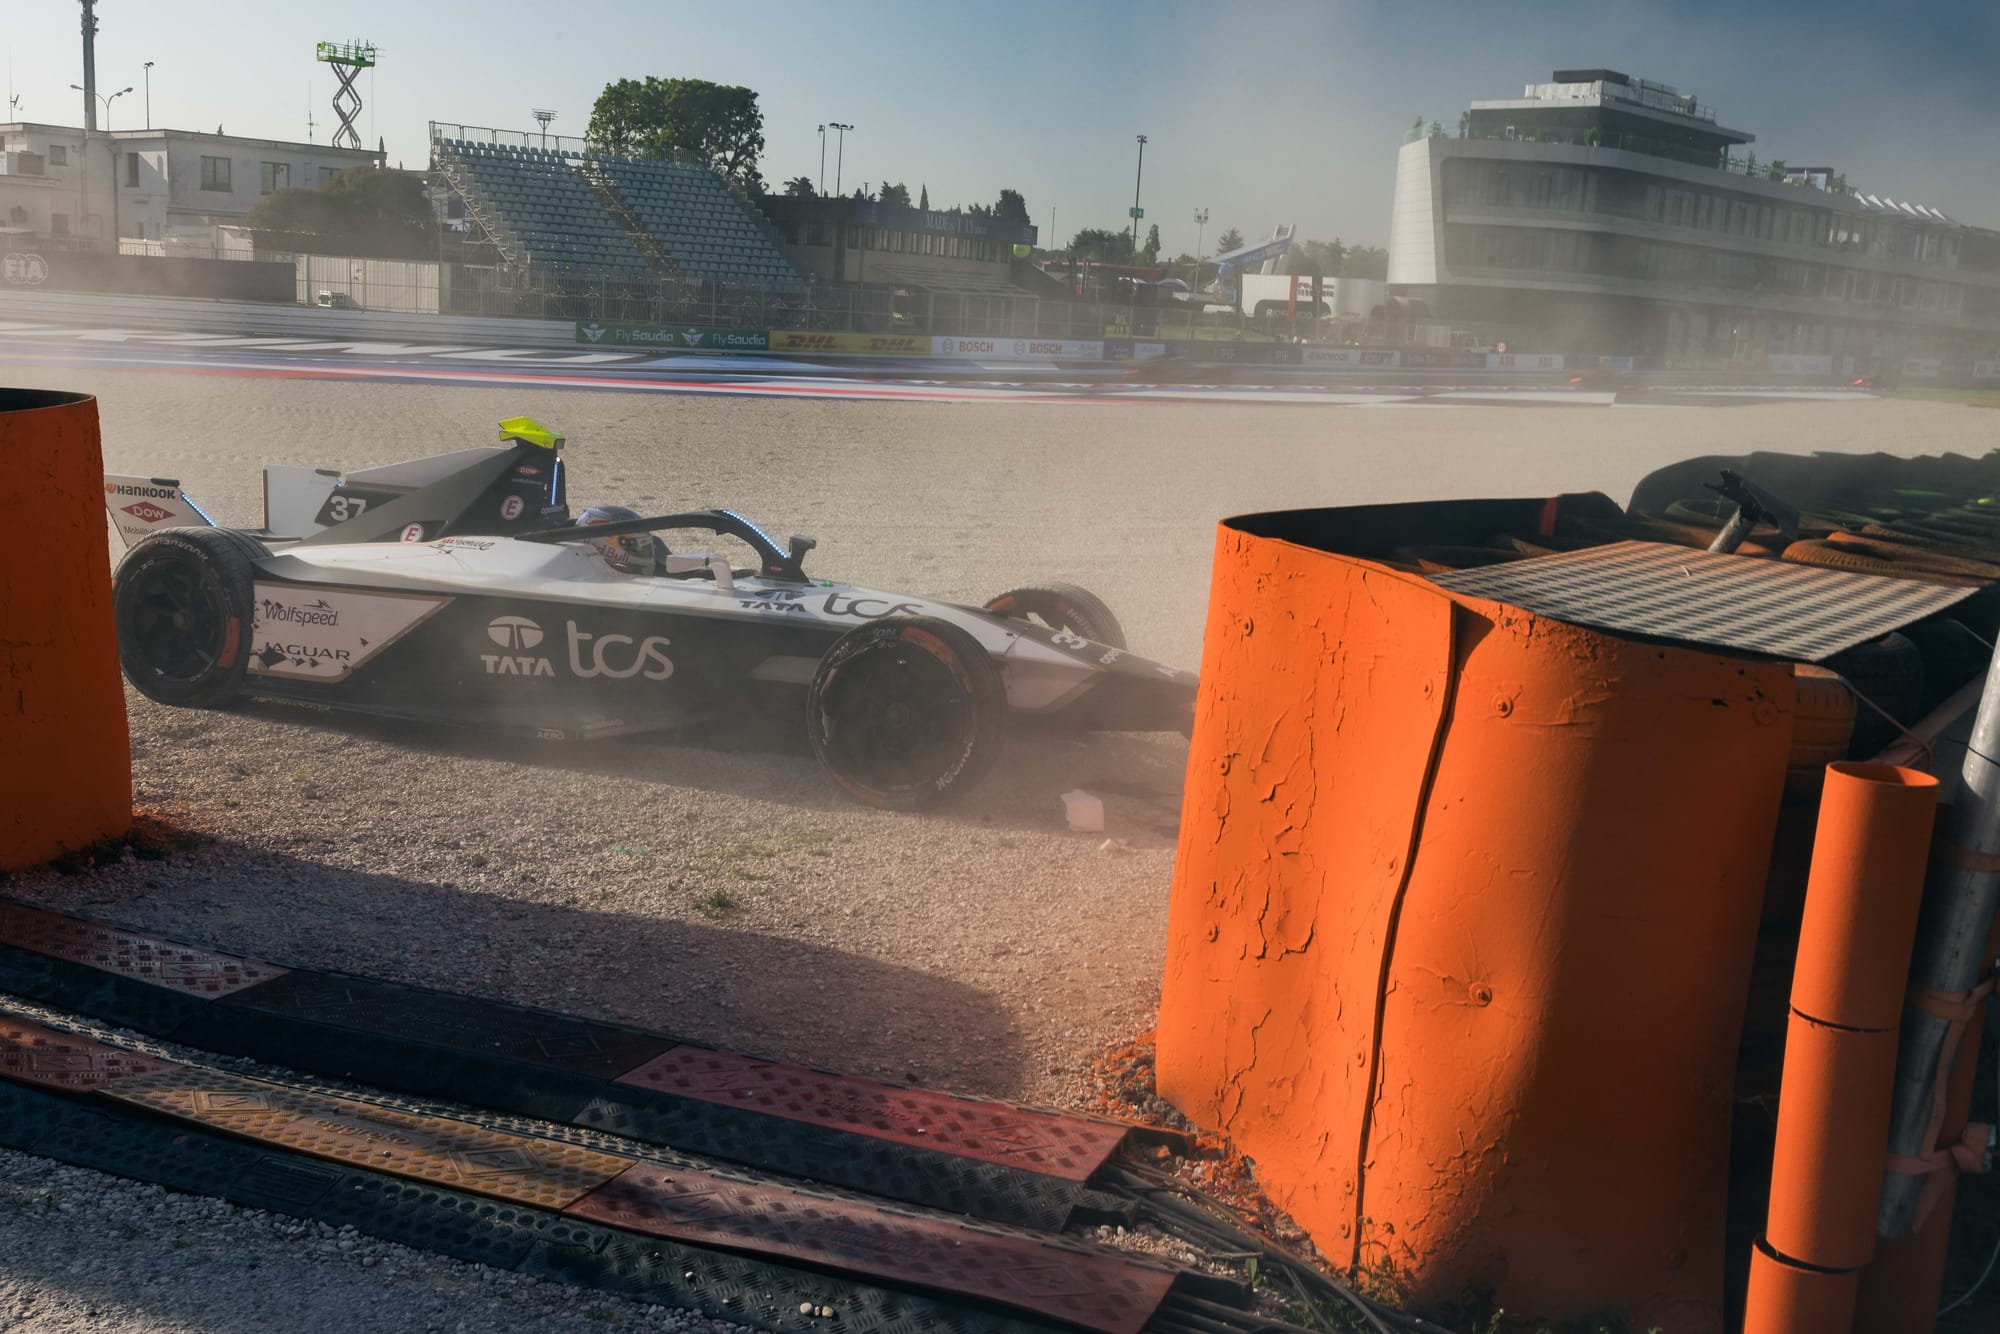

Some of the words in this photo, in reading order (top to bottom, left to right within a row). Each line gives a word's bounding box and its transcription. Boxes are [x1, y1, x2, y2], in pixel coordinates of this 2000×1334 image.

[4, 259, 44, 279] FIA
[786, 335, 837, 349] DHL
[869, 338, 918, 351] DHL
[958, 341, 994, 353] BOSCH
[1029, 343, 1063, 355] BOSCH
[331, 497, 367, 521] 37
[739, 600, 807, 612] TATA
[566, 619, 674, 681] tcs
[480, 654, 556, 677] TATA
